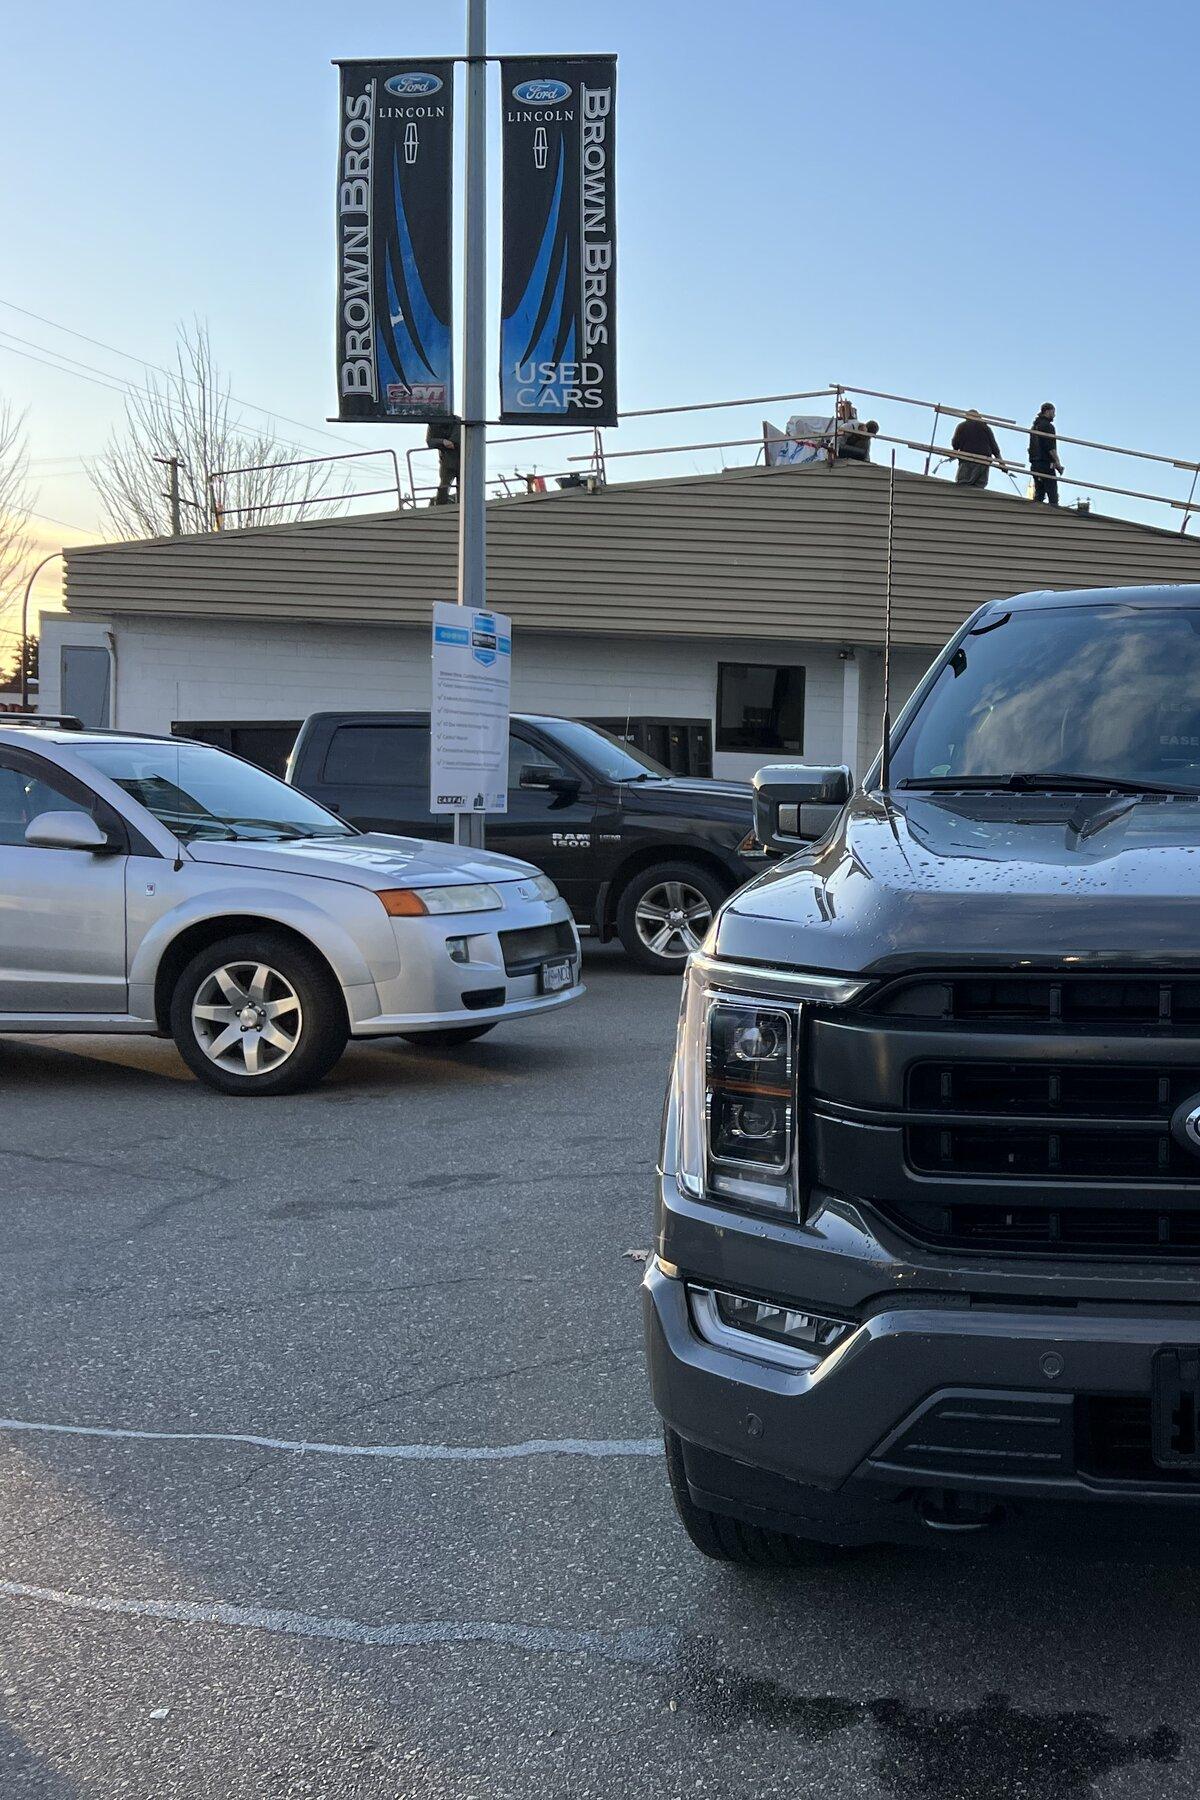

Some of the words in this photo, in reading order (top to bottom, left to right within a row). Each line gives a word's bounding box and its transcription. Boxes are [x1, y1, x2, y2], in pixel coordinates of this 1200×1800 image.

[397, 77, 429, 92] Ford
[526, 84, 558, 100] Ford
[379, 107, 446, 118] LINCOLN
[508, 110, 575, 122] LINCOLN
[340, 83, 374, 216] BROS.
[583, 86, 611, 233] BROWN
[584, 240, 612, 356] BROS.
[342, 225, 374, 398] BROWN
[515, 362, 604, 384] USED
[517, 388, 604, 408] CARS
[552, 840, 591, 848] 1500
